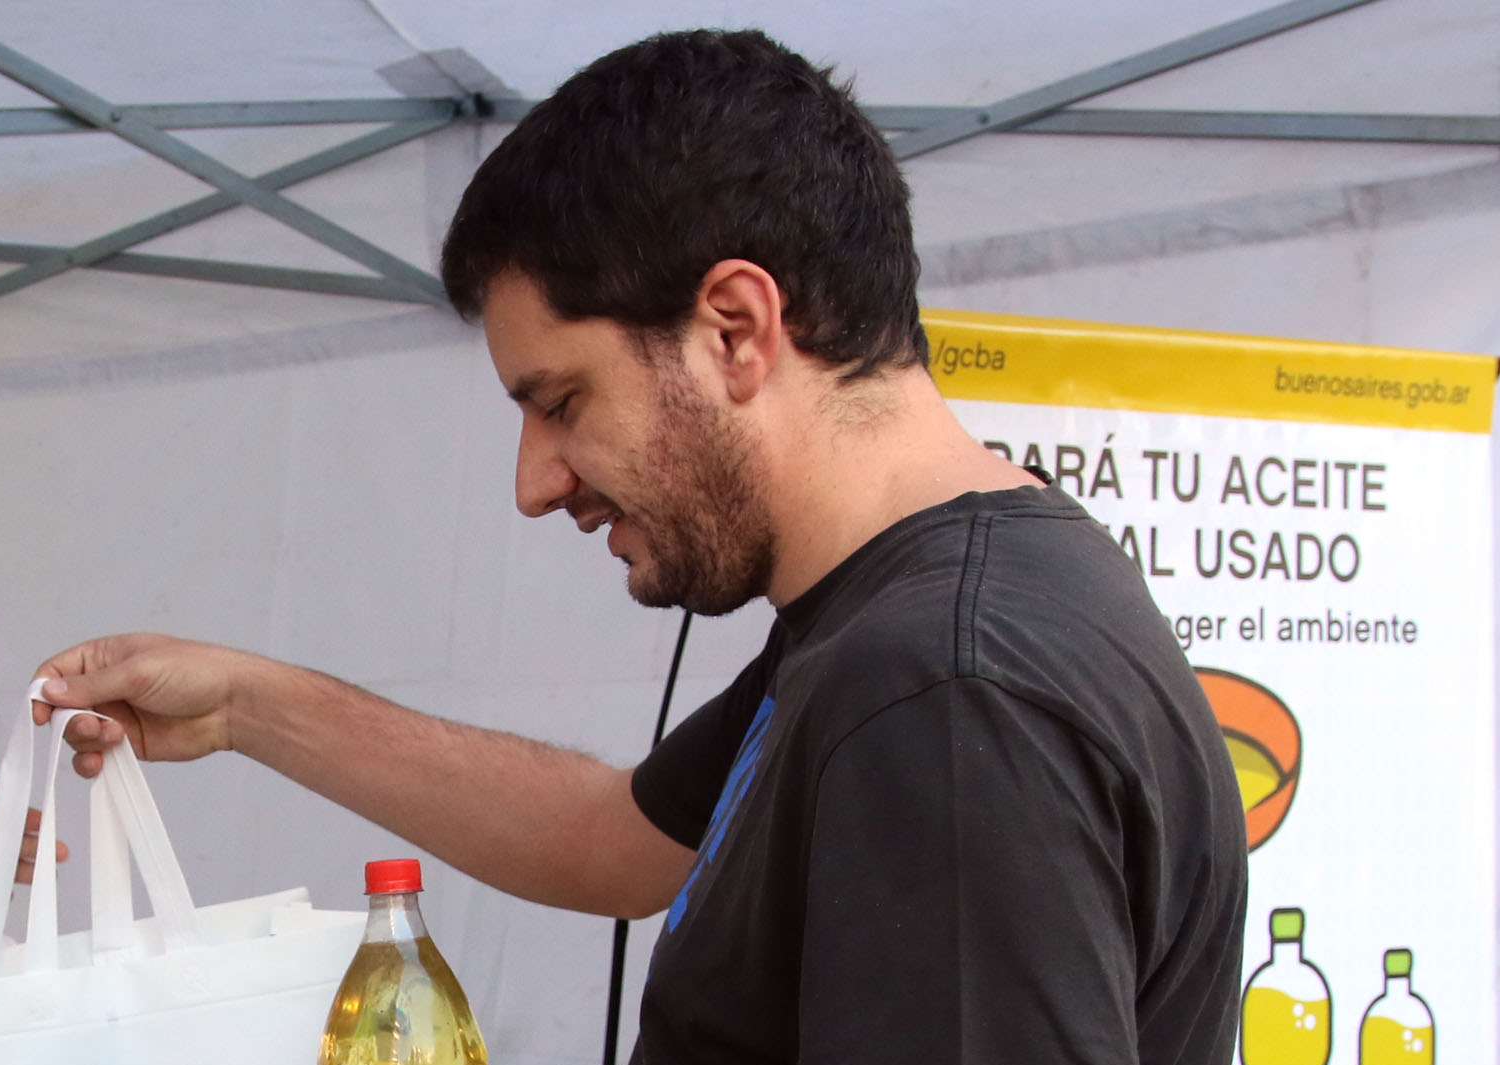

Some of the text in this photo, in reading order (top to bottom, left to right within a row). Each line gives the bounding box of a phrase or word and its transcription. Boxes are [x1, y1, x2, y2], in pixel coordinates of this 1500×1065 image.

[1275, 366, 1470, 409] buenosaires.gob.ar
[1142, 450, 1200, 502] TU
[1221, 455, 1387, 511] ACEITE
[1106, 525, 1361, 583] AL USADO
[1239, 606, 1265, 641] el
[1277, 608, 1418, 644] ambiente
